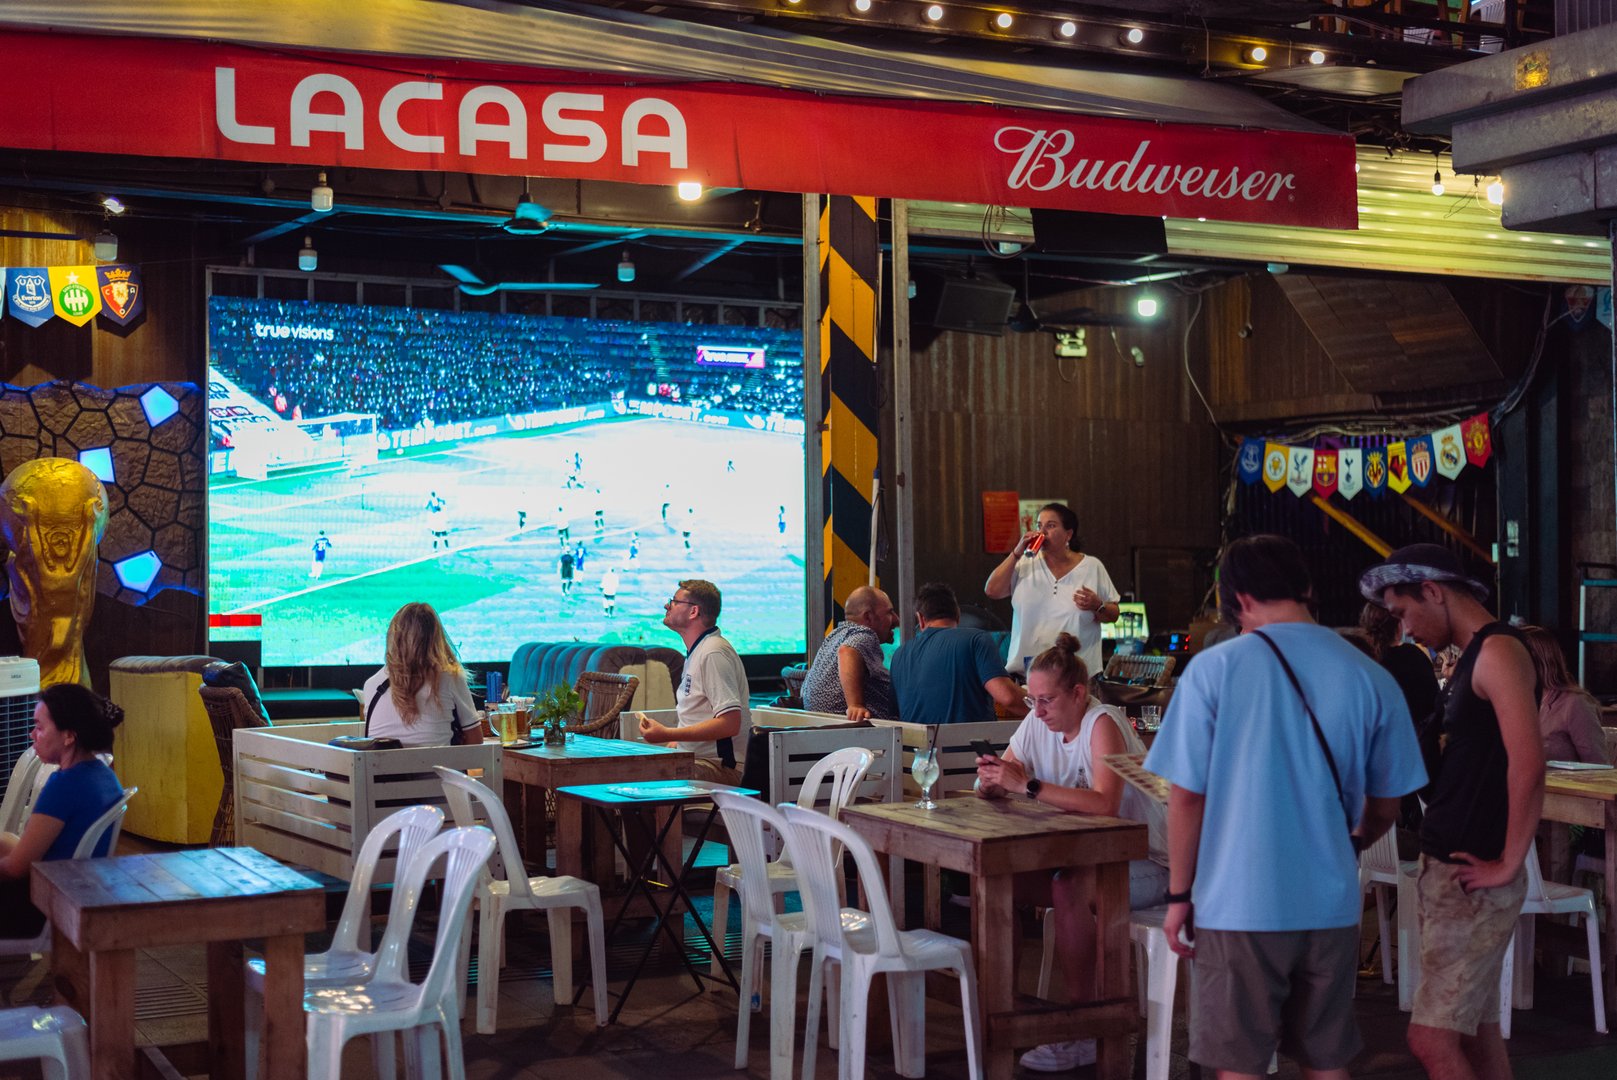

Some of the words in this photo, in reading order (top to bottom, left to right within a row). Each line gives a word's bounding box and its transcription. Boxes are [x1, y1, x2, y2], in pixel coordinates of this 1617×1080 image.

[993, 126, 1296, 201] Budweiser
[255, 322, 290, 338] true
[291, 324, 334, 341] visions
